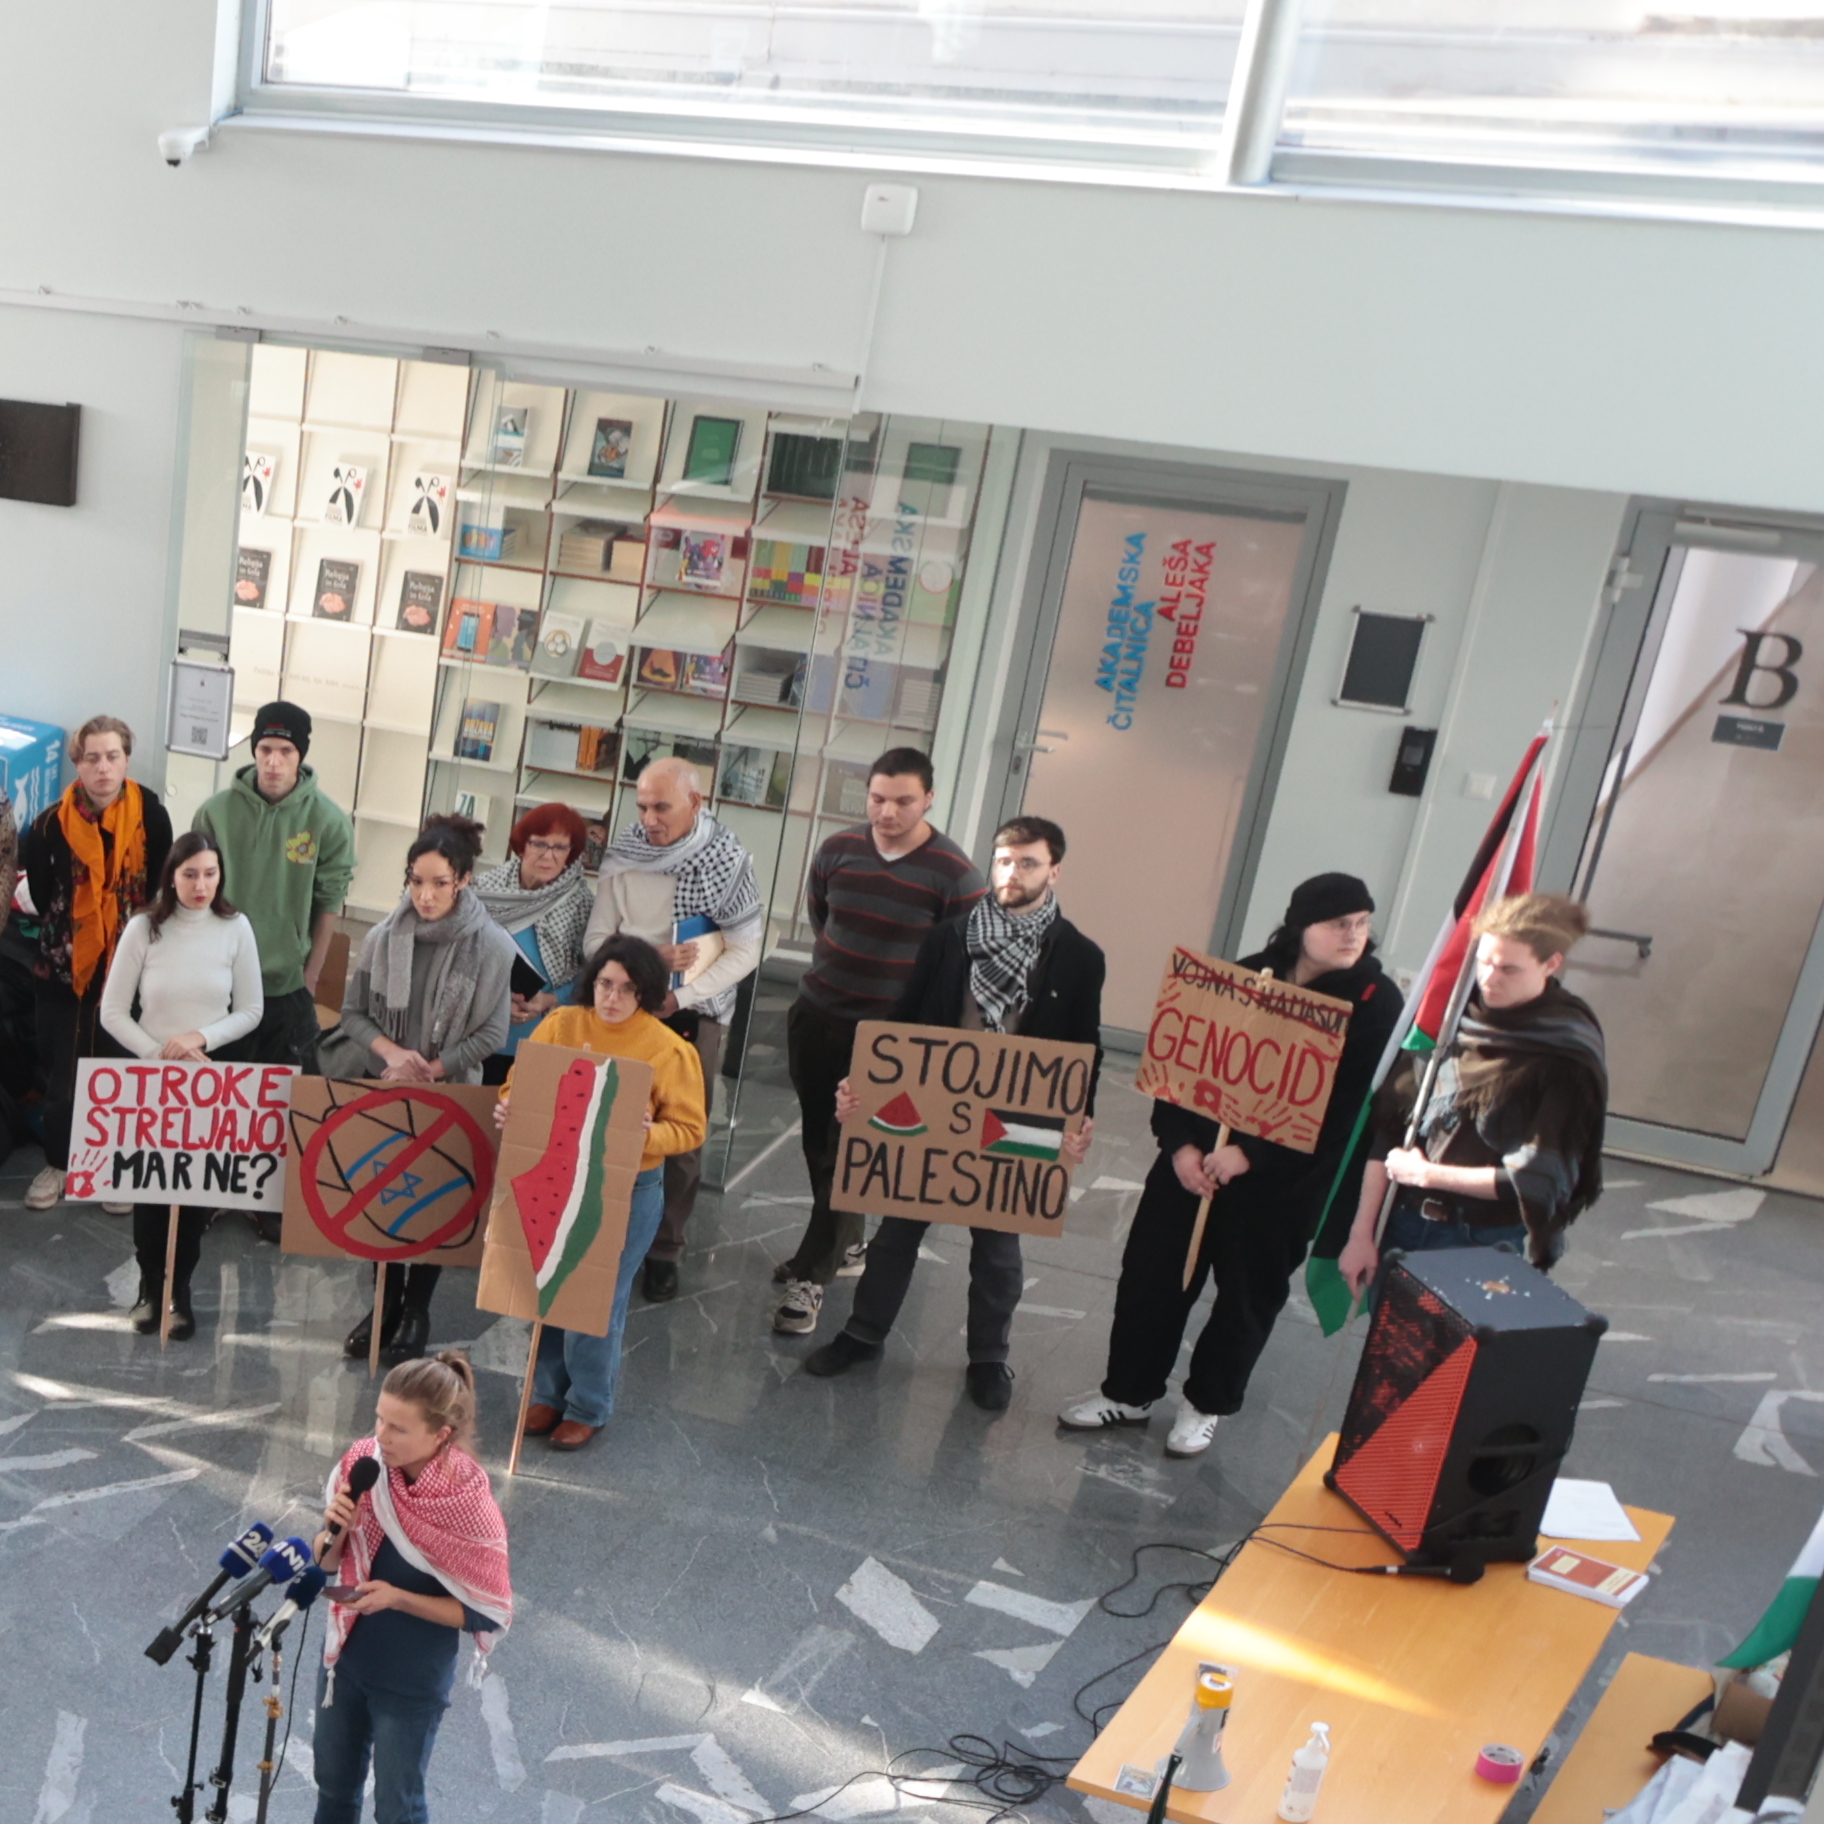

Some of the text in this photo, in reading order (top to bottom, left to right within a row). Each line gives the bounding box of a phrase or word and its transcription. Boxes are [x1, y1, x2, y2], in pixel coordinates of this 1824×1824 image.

[1095, 532, 1148, 692] AKADEMSKA
[1157, 539, 1193, 622] ALEŠA
[1165, 541, 1218, 689] DEBELJAKA
[1106, 601, 1156, 731] ČITALNICA
[1718, 627, 1803, 709] B
[1172, 953, 1235, 1001] VOJNA
[88, 1065, 294, 1109] OTROKE
[867, 1033, 1089, 1116] STOJIMO
[1148, 1007, 1326, 1107] GENOCID
[85, 1106, 288, 1157] STRELJAJO,
[948, 1101, 972, 1135] S
[112, 1150, 278, 1200] MAR NE?
[841, 1137, 1069, 1221] PALESTINO
[242, 1530, 269, 1559] 24
[281, 1545, 306, 1572] N1
